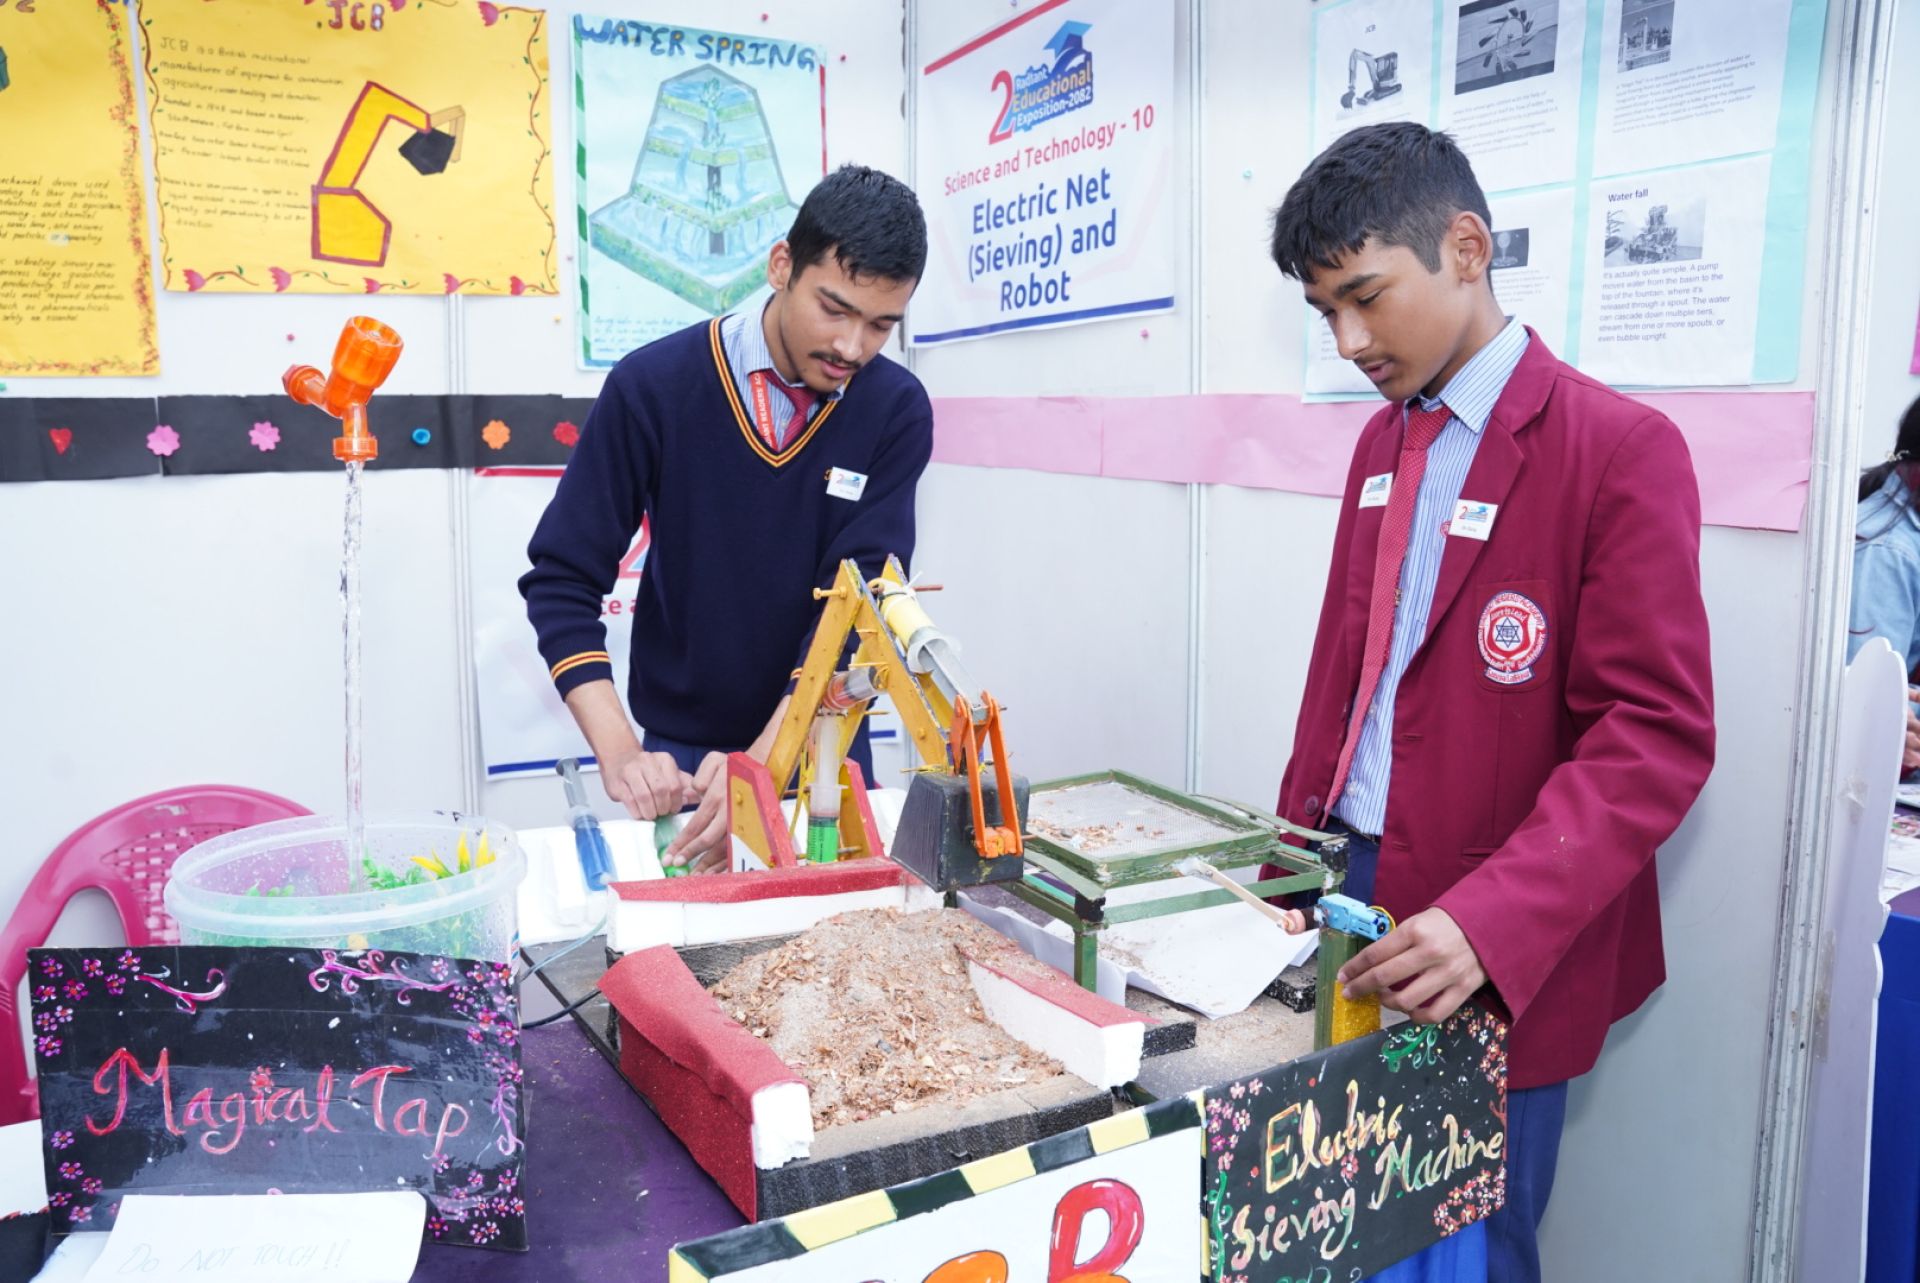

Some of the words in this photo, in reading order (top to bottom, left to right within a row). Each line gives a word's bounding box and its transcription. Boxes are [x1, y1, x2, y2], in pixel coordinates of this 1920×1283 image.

[326, 0, 384, 31] JCB
[160, 36, 188, 52] JCB
[573, 13, 686, 58] WATER
[695, 34, 816, 72] SPRING
[1012, 60, 1092, 114] Educational
[1015, 66, 1048, 90] Radiant
[988, 70, 1014, 145] 2
[1016, 86, 1092, 128] Exposition-2082
[945, 165, 990, 196] Science
[994, 150, 1020, 178] and
[1025, 121, 1116, 169] Technology
[1132, 104, 1154, 132] 10
[973, 182, 1057, 235] Electric
[1066, 167, 1111, 210] Net
[1608, 192, 1633, 203] Water
[1635, 188, 1649, 198] fall
[968, 222, 1062, 283] (Sieving)
[1071, 207, 1117, 254] and
[1614, 269, 1641, 279] actually
[1641, 268, 1660, 277] quite
[1697, 263, 1719, 273] pump
[1627, 280, 1646, 288] water
[1647, 278, 1664, 286] from
[1680, 275, 1700, 284] basin
[1701, 274, 1709, 282] to
[1711, 272, 1724, 281] the
[1001, 270, 1070, 312] Robot
[1600, 302, 1630, 311] released
[1631, 301, 1659, 311] through
[1692, 296, 1707, 305] The
[1708, 295, 1730, 304] water
[1601, 293, 1613, 302] top
[1613, 292, 1622, 300] of
[1622, 291, 1633, 299] the
[1667, 287, 1690, 296] where
[1598, 324, 1623, 332] stream
[1624, 322, 1640, 331] from
[1641, 322, 1655, 330] one
[1656, 321, 1664, 329] or
[1666, 320, 1686, 329] more
[1716, 317, 1726, 326] or
[1599, 313, 1612, 321] can
[1614, 311, 1643, 320] cascade
[1644, 310, 1664, 319] down
[1666, 308, 1695, 319] multiple
[1598, 334, 1615, 342] even
[1616, 331, 1641, 341] bubble
[84, 1047, 341, 1155] Magical
[350, 1064, 469, 1160] Tap
[1265, 1079, 1404, 1195] Electric
[1231, 1187, 1356, 1271] Sieving
[1368, 1114, 1504, 1210] Machine
[177, 1245, 242, 1273] NOT
